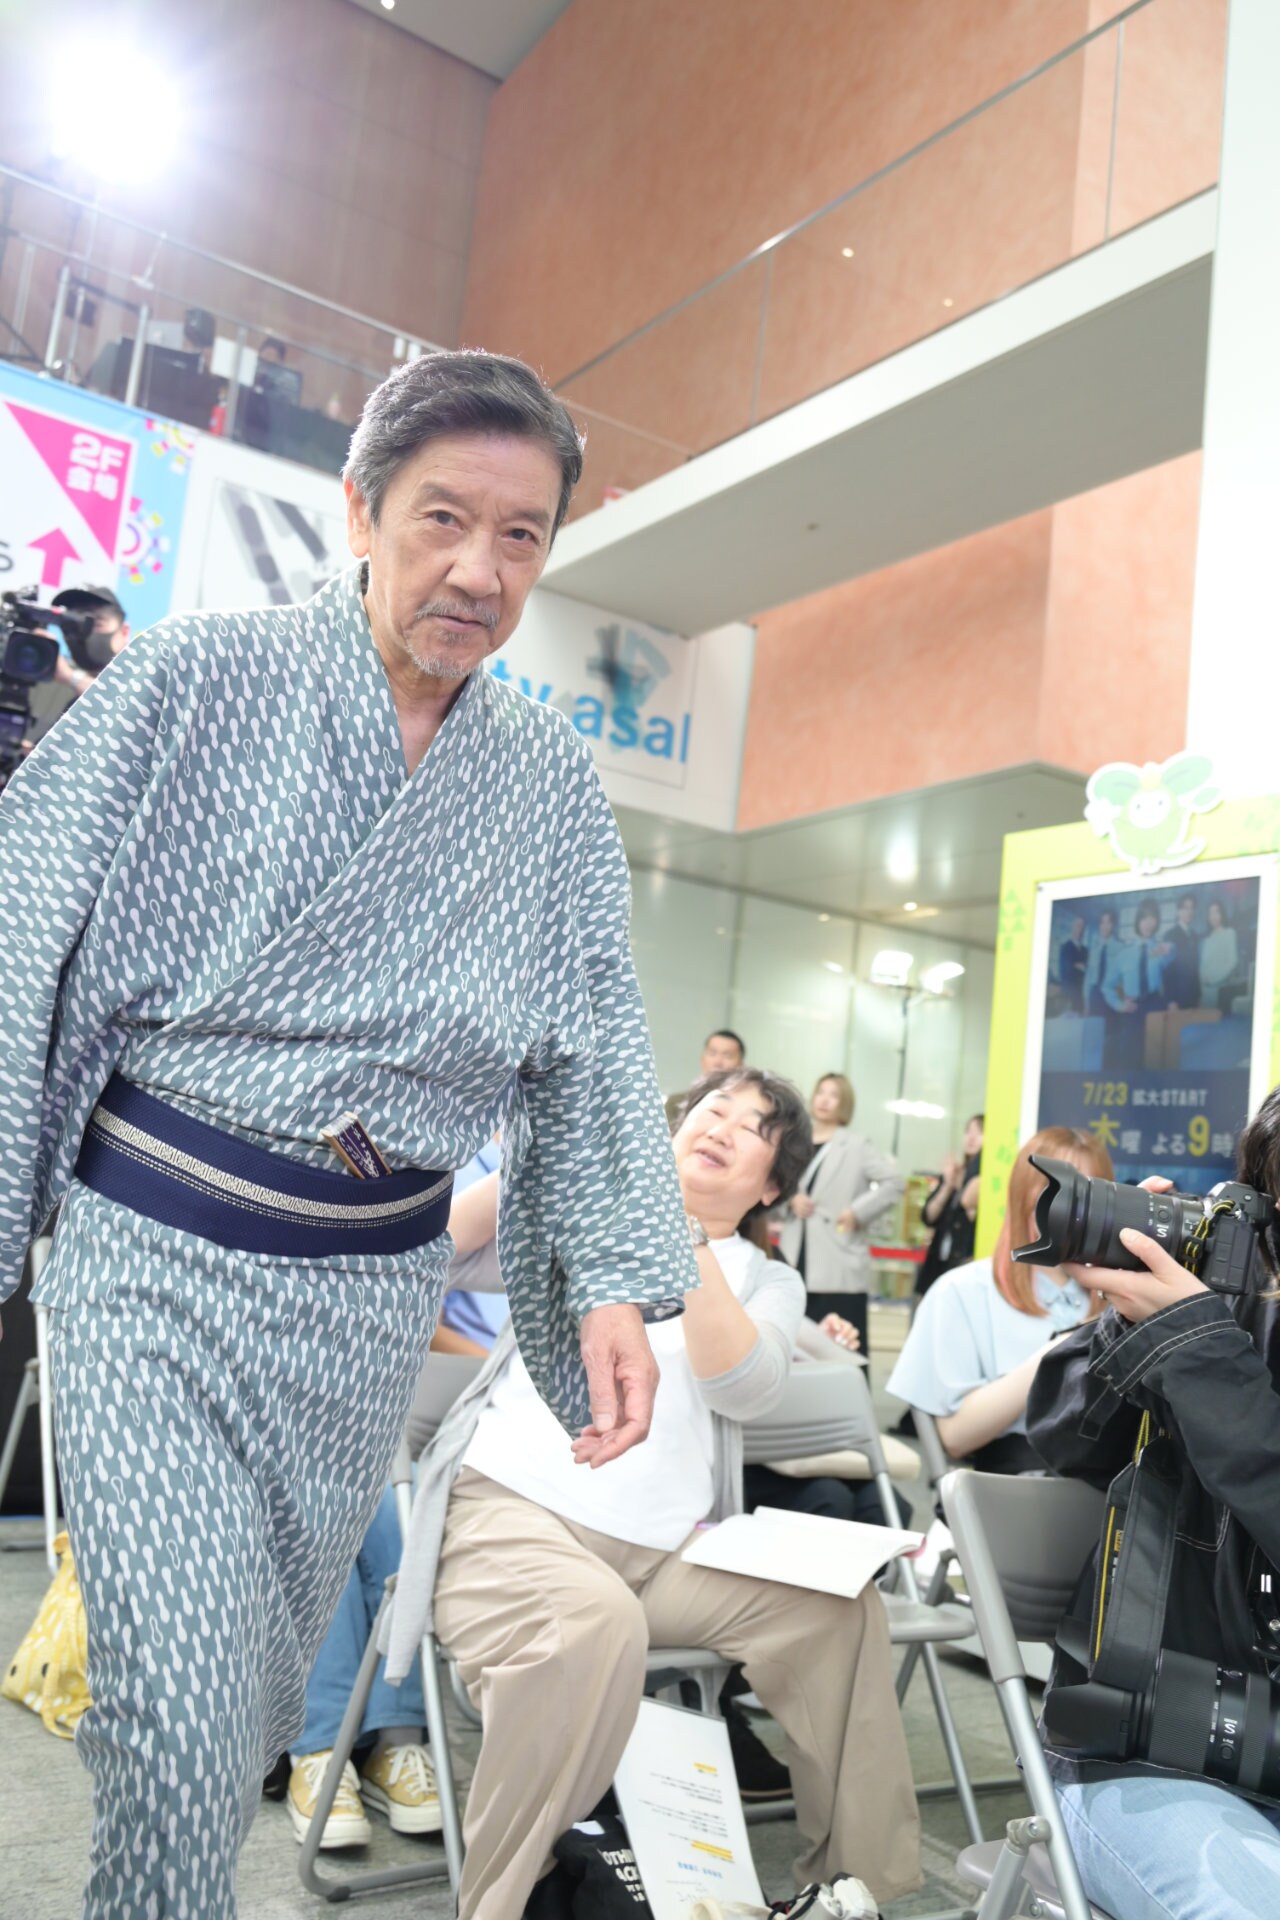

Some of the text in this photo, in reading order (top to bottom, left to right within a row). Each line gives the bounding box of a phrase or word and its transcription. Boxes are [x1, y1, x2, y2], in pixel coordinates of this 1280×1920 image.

[70, 433, 125, 472] 2F
[1083, 1081, 1129, 1107] 7/23
[1088, 1112, 1234, 1158] 木曜 よる9時
